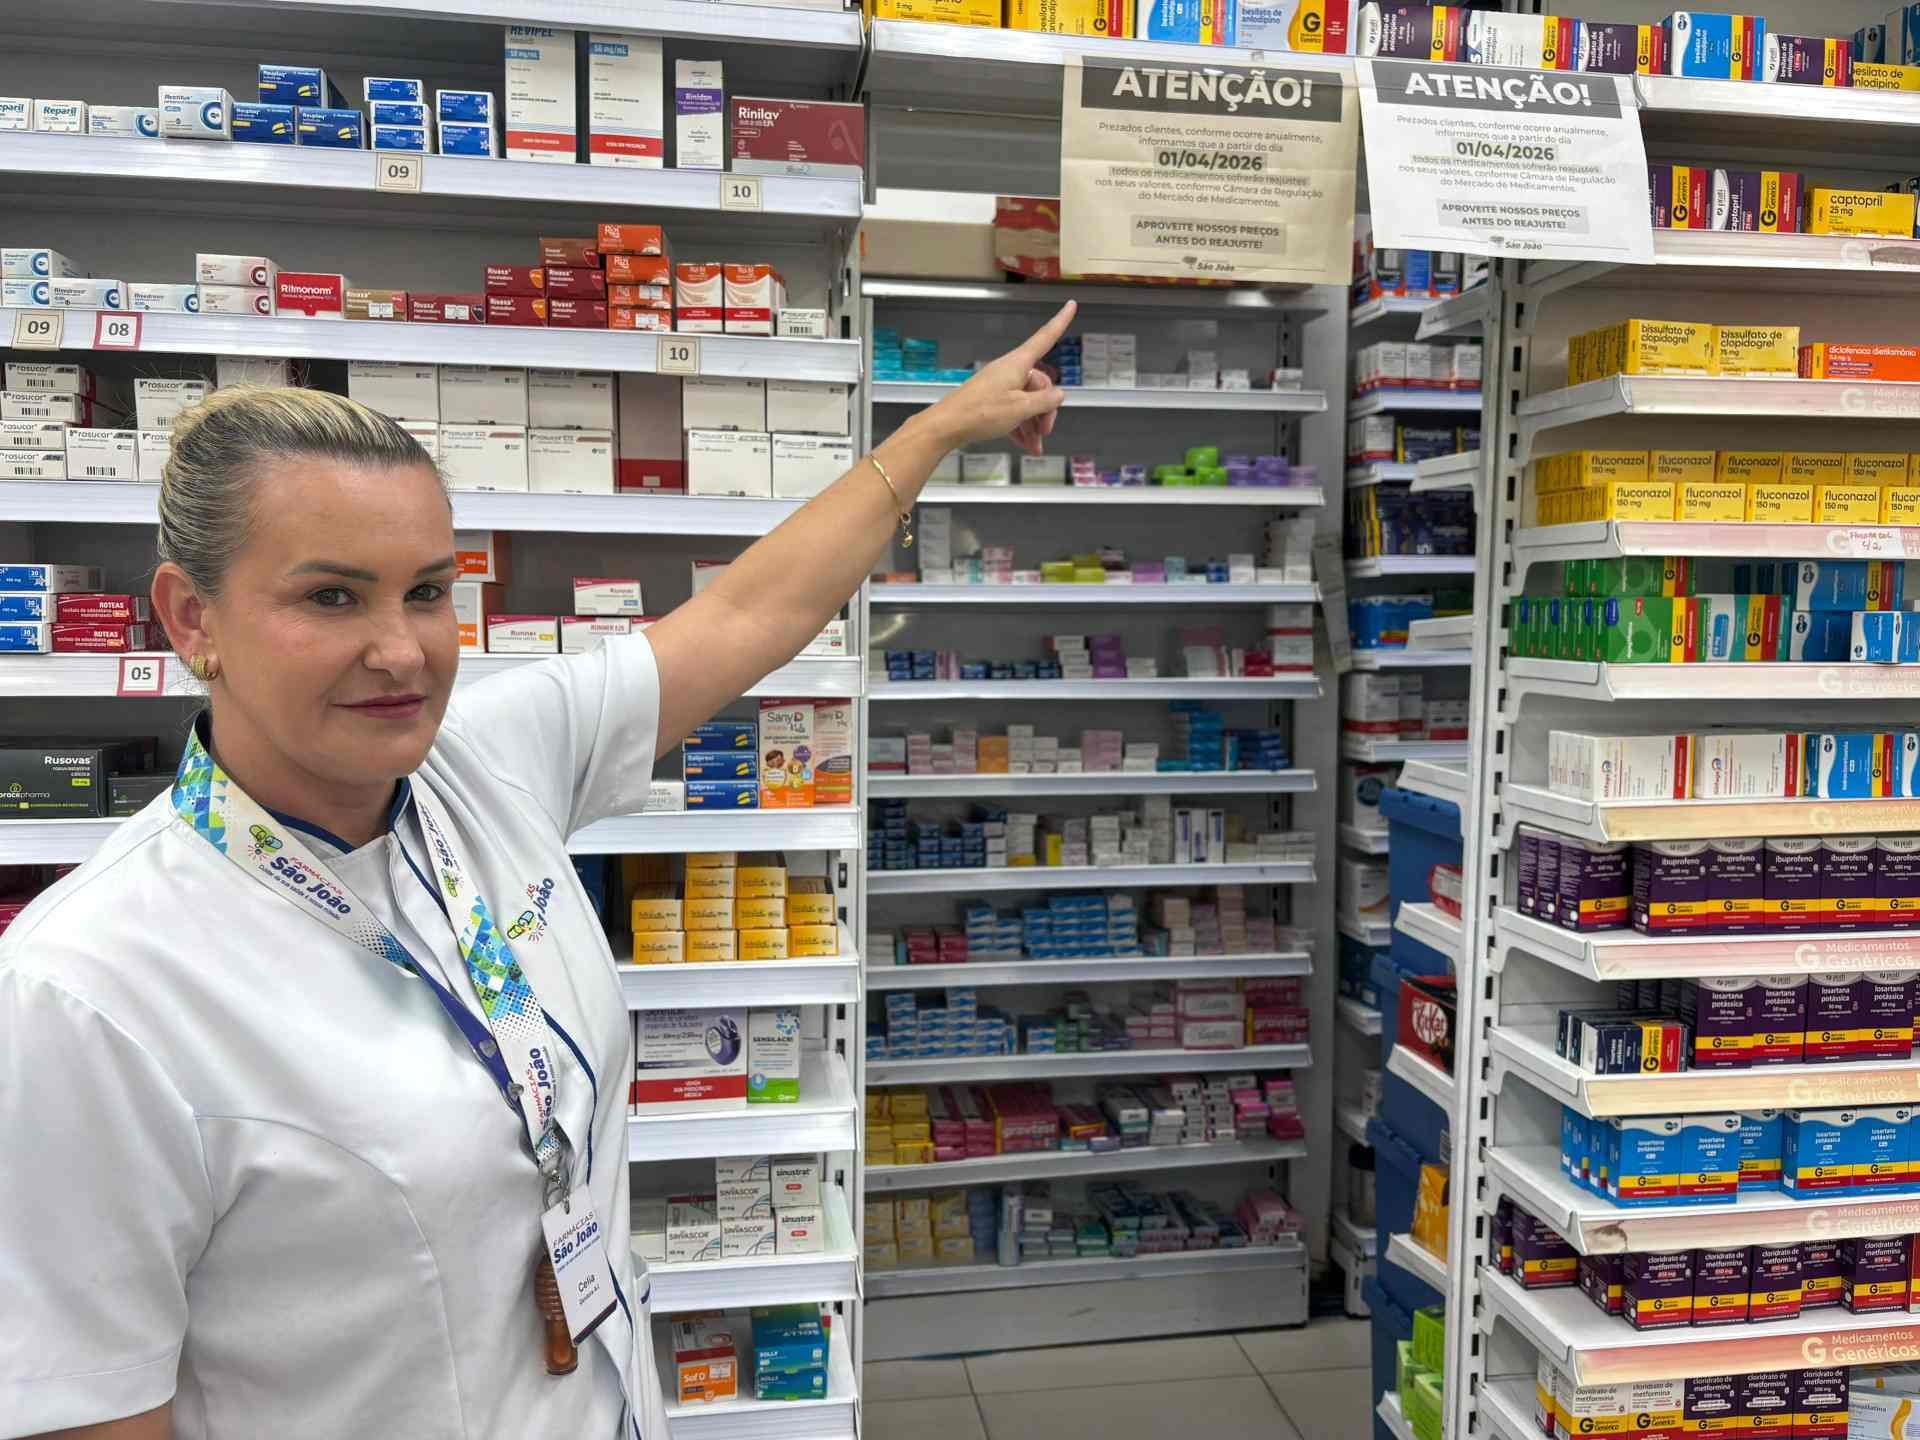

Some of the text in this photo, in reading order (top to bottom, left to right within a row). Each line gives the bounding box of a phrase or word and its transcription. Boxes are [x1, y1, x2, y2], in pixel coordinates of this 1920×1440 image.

[1851, 66, 1904, 79] esilato de
[1112, 67, 1313, 112] ATENÇÃO!
[1855, 77, 1900, 89] nlodipino
[1405, 72, 1592, 109] ATENÇÃO!
[43, 105, 77, 117] Reparil
[738, 107, 780, 121] Rinilav
[1456, 140, 1555, 160] 01/04/2026
[1159, 150, 1263, 171] 01/04/2026
[388, 164, 410, 179] 09
[731, 184, 752, 199] 10
[1830, 194, 1883, 208] captopril
[1441, 203, 1581, 219] APROVEITE NOSSOS PREÇOS
[1829, 206, 1853, 217] 25 mg
[1136, 220, 1280, 238] APROVEITE NOSSOS PREÇOS
[1462, 217, 1566, 229] ANTES DO REAJUSTE!
[1155, 236, 1264, 249] ANTES DO REAJUSTE!
[281, 284, 332, 296] Ritmonorm
[27, 320, 50, 335] 09
[108, 322, 129, 337] 08
[1641, 322, 1696, 336] bissulfato de
[1720, 328, 1783, 340] bissulfato de
[1641, 333, 1689, 346] clopidogrel
[1720, 337, 1775, 350] clopidogrel
[669, 346, 689, 362] 10
[1592, 456, 1645, 465] fluconazol
[1854, 457, 1905, 468] fluconazol
[1617, 487, 1672, 498] fluconazol
[1686, 488, 1742, 499] fluconazol
[1756, 488, 1810, 501] fluconazol
[1825, 488, 1877, 501] fluconazol
[1825, 501, 1849, 511] 150 mg
[99, 601, 124, 609] ROTEAS
[131, 666, 151, 680] 05
[44, 755, 91, 765] Rusovas
[1662, 858, 1700, 866] ibuprofeno
[1831, 854, 1868, 863] ibuprofeno
[270, 856, 307, 884] São
[306, 883, 351, 914] João
[1826, 942, 1911, 953] Medicamentos
[1825, 953, 1914, 969] Genéricos
[1711, 992, 1744, 1000] losartana
[1821, 987, 1850, 995] losartana
[529, 1048, 551, 1090] João
[776, 1168, 810, 1177] sinustrat
[781, 1215, 815, 1223] sinustrat
[553, 1221, 598, 1264] São João
[1648, 1254, 1688, 1264] cloridrato de
[1648, 1262, 1686, 1271] metformina
[1832, 1330, 1914, 1345] Medicamentos
[1801, 1336, 1919, 1364] G Genéricos
[1803, 1369, 1843, 1379] cloridrato de
[1804, 1377, 1842, 1386] metformina
